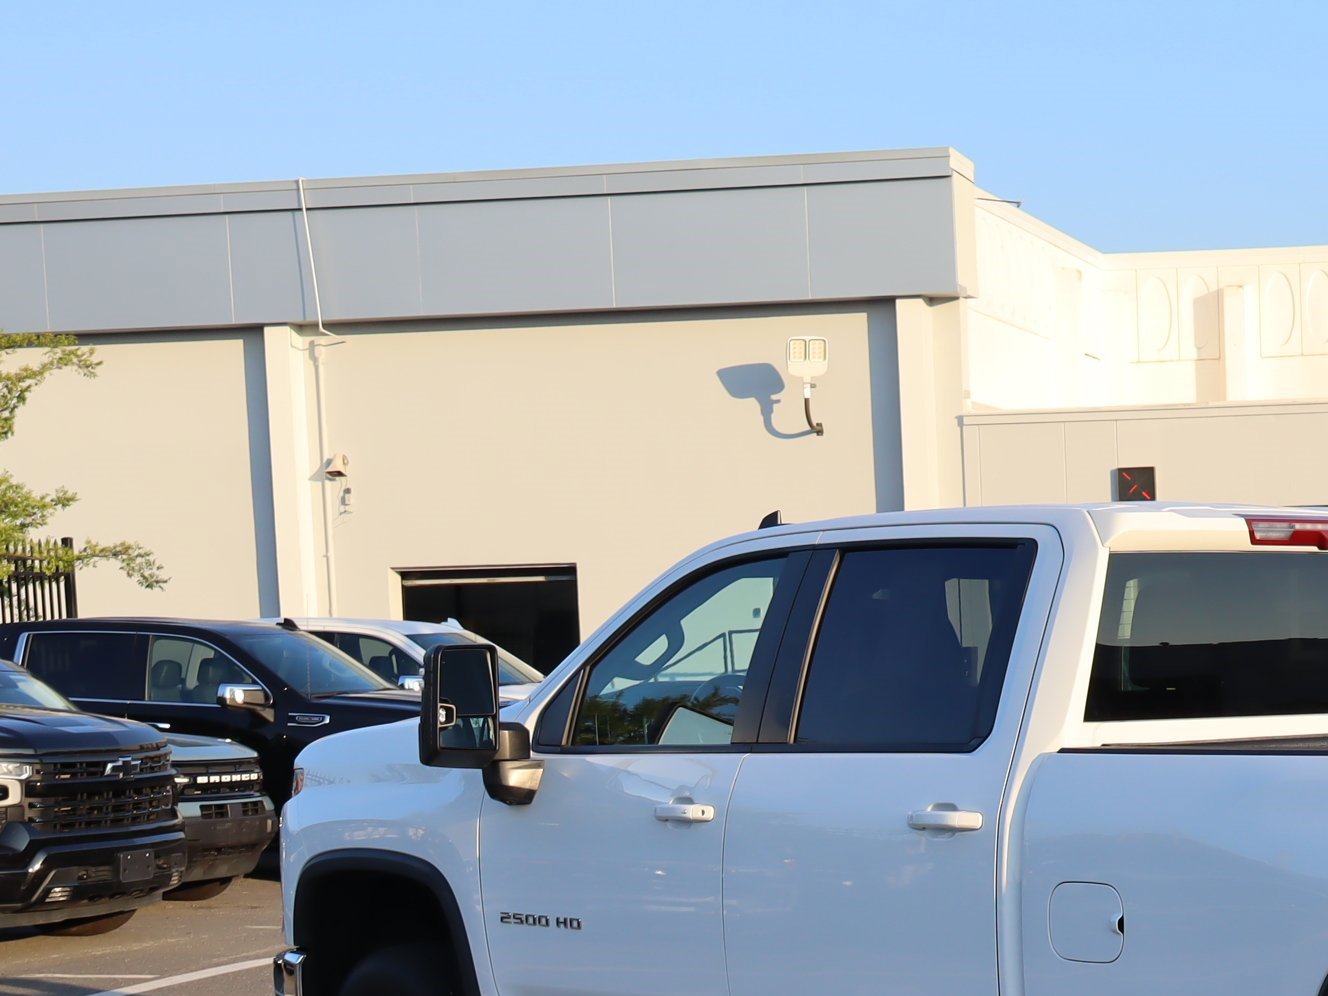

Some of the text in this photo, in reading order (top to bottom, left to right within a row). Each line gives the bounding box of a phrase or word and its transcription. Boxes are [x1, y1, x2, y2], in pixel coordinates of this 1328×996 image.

[196, 772, 258, 784] BRONCO
[500, 911, 582, 931] 2500 HD
